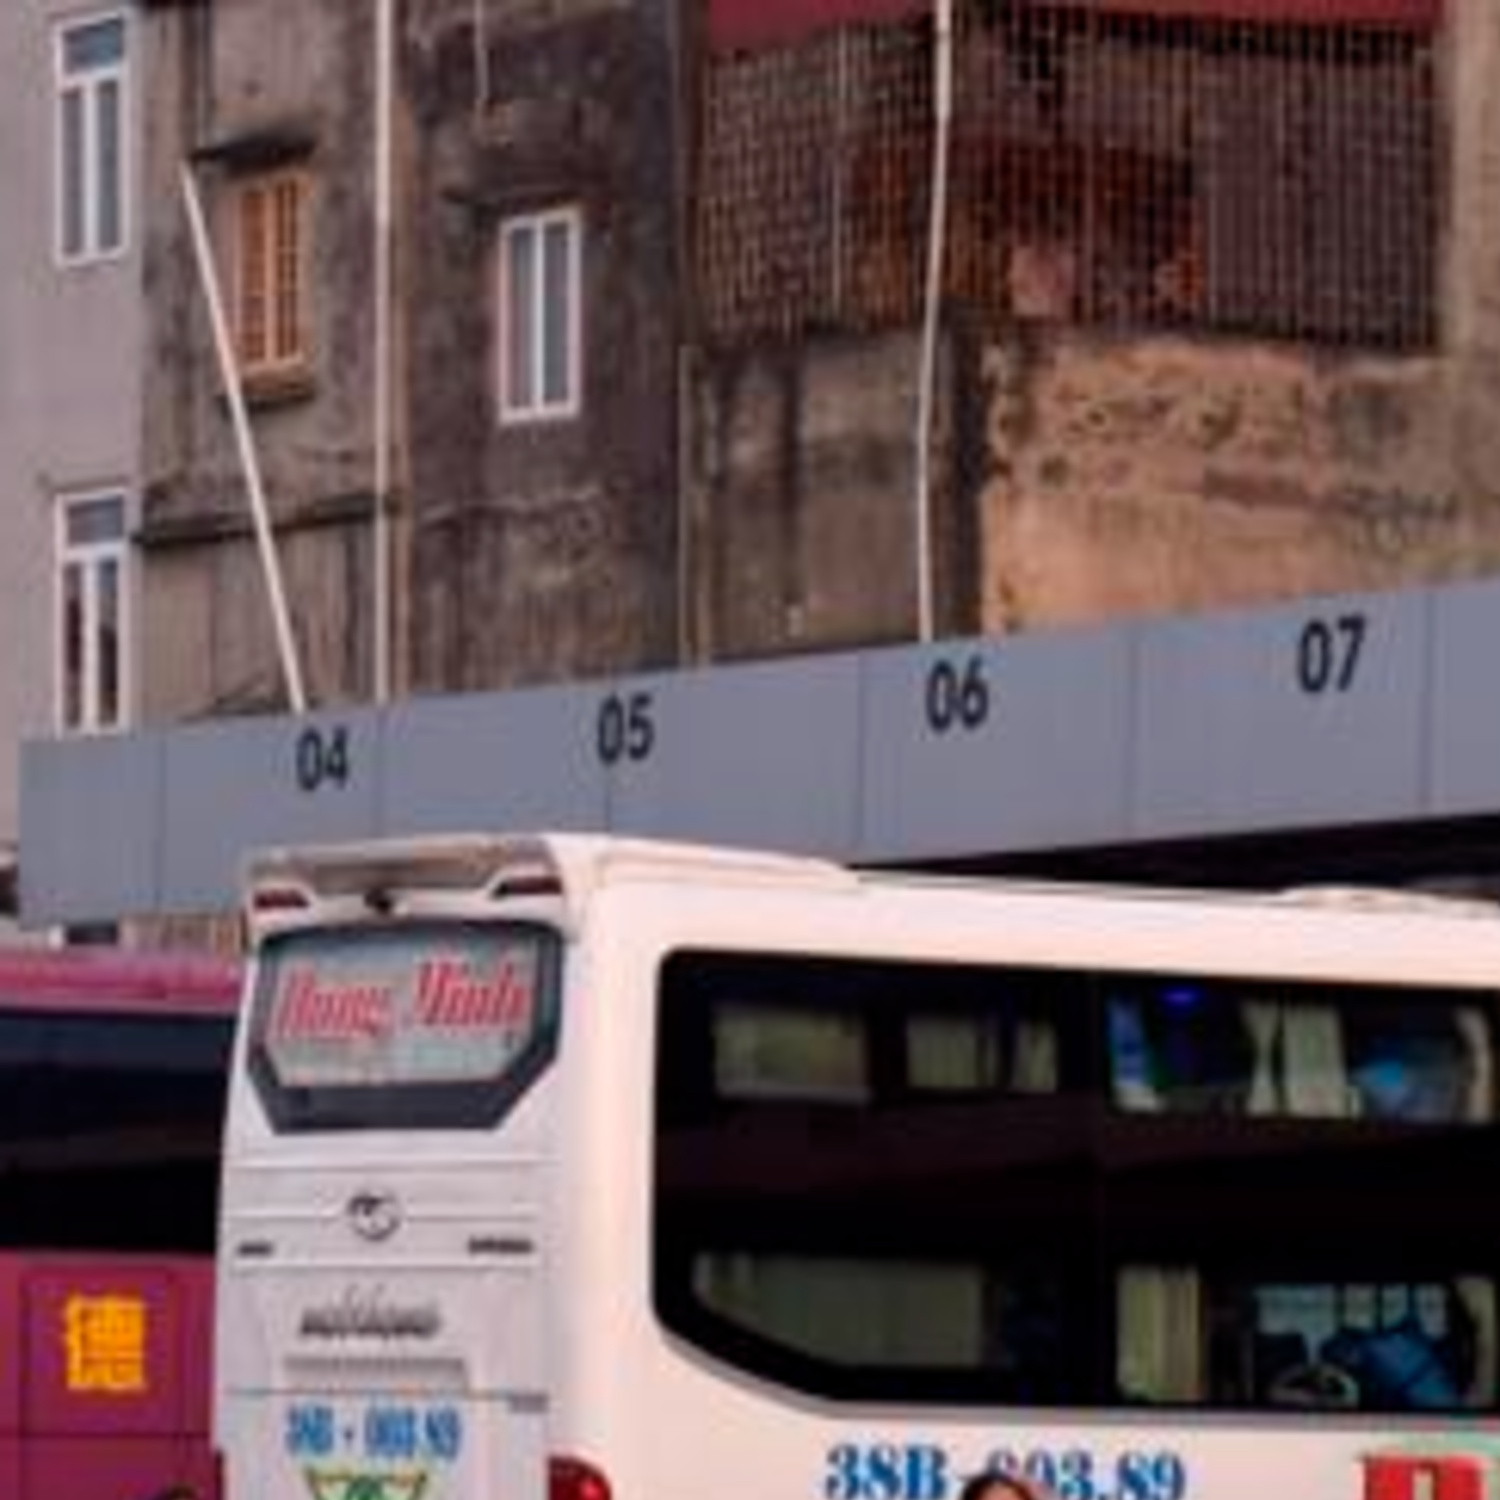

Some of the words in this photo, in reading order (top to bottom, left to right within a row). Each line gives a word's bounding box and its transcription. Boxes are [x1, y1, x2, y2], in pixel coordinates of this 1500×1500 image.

[1297, 615, 1366, 694] 07
[597, 694, 655, 767] 05
[925, 657, 989, 731] 06
[298, 727, 349, 791] 04
